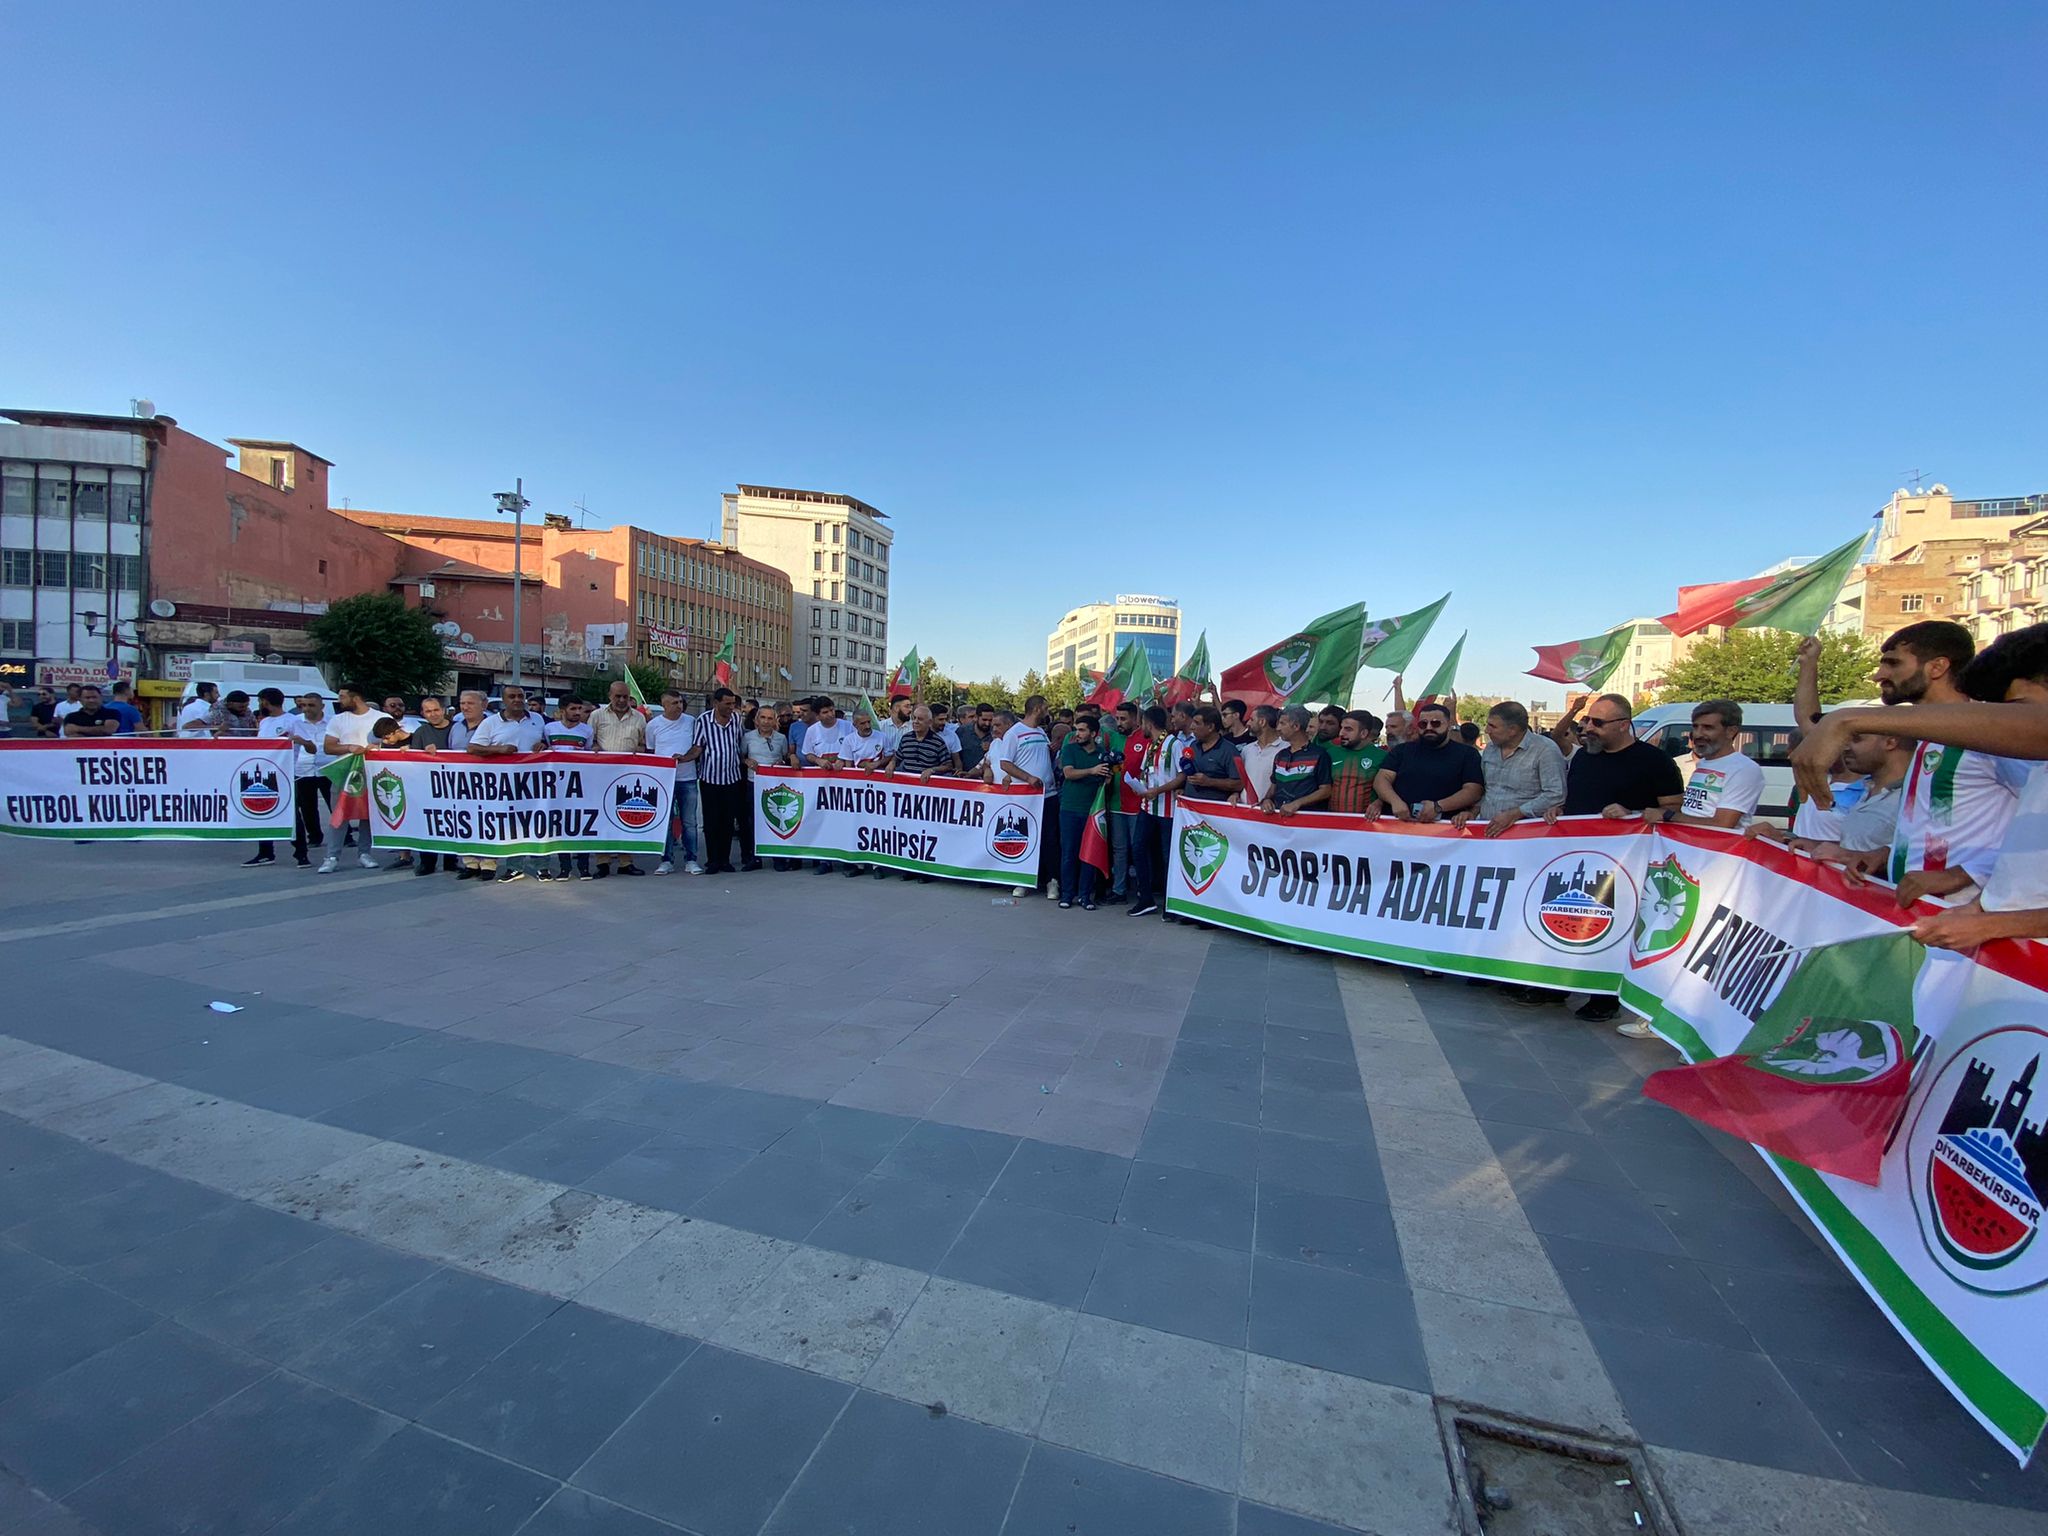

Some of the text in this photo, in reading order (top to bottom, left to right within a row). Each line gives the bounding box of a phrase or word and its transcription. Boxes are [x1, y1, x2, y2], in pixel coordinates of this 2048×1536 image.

[76, 751, 168, 785] TESİSLER
[430, 764, 583, 801] DİYARBAKIR'A
[7, 788, 228, 823] FUTBOL KULÜPLERİNDİR
[423, 804, 599, 841] TESİS İSTİYORUZ
[816, 783, 985, 828] AMATÖR TAKIMLAR
[857, 822, 938, 862] SAHİPSİZ
[1240, 843, 1516, 931] SPOR'DA ADALET
[1541, 905, 1613, 916] DİYARBEKİRSPOR
[1935, 1139, 2040, 1225] DİYARBEKİRSPOR
